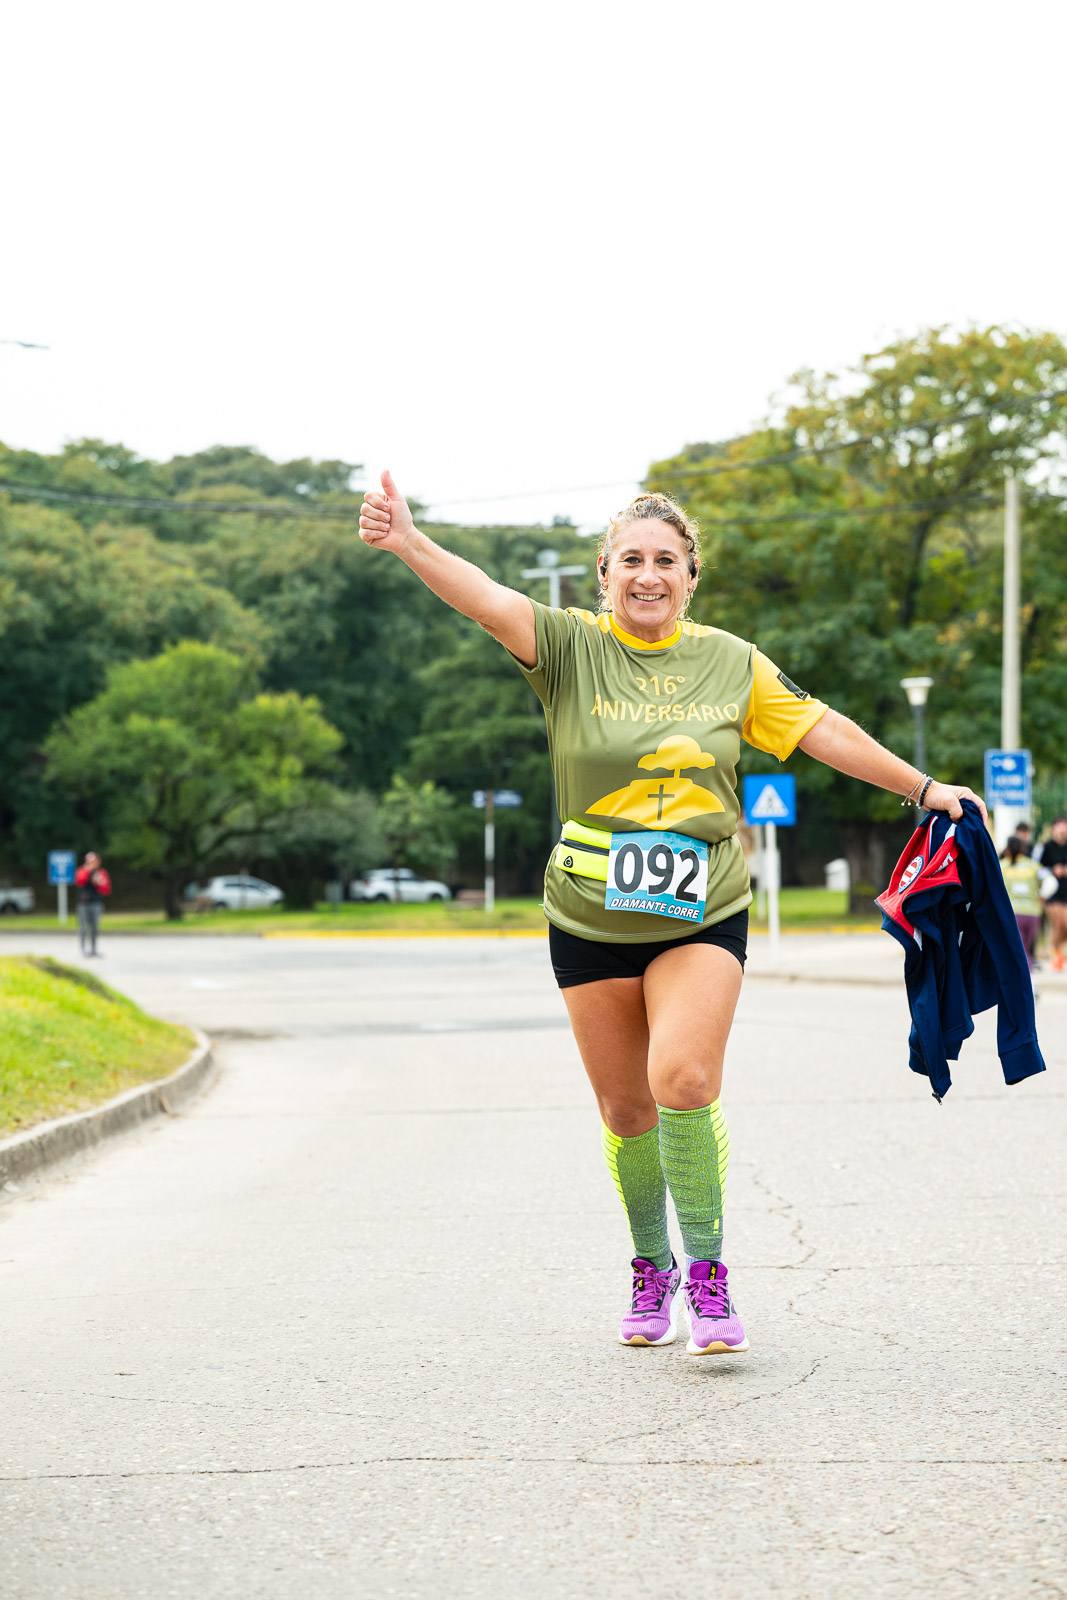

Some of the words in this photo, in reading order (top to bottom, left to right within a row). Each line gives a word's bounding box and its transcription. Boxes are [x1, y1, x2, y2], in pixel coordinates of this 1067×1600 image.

[590, 693, 740, 723] ANIVERSARIO
[614, 842, 700, 904] 092
[610, 897, 667, 913] DIAMANTE
[667, 904, 701, 919] CORRE
